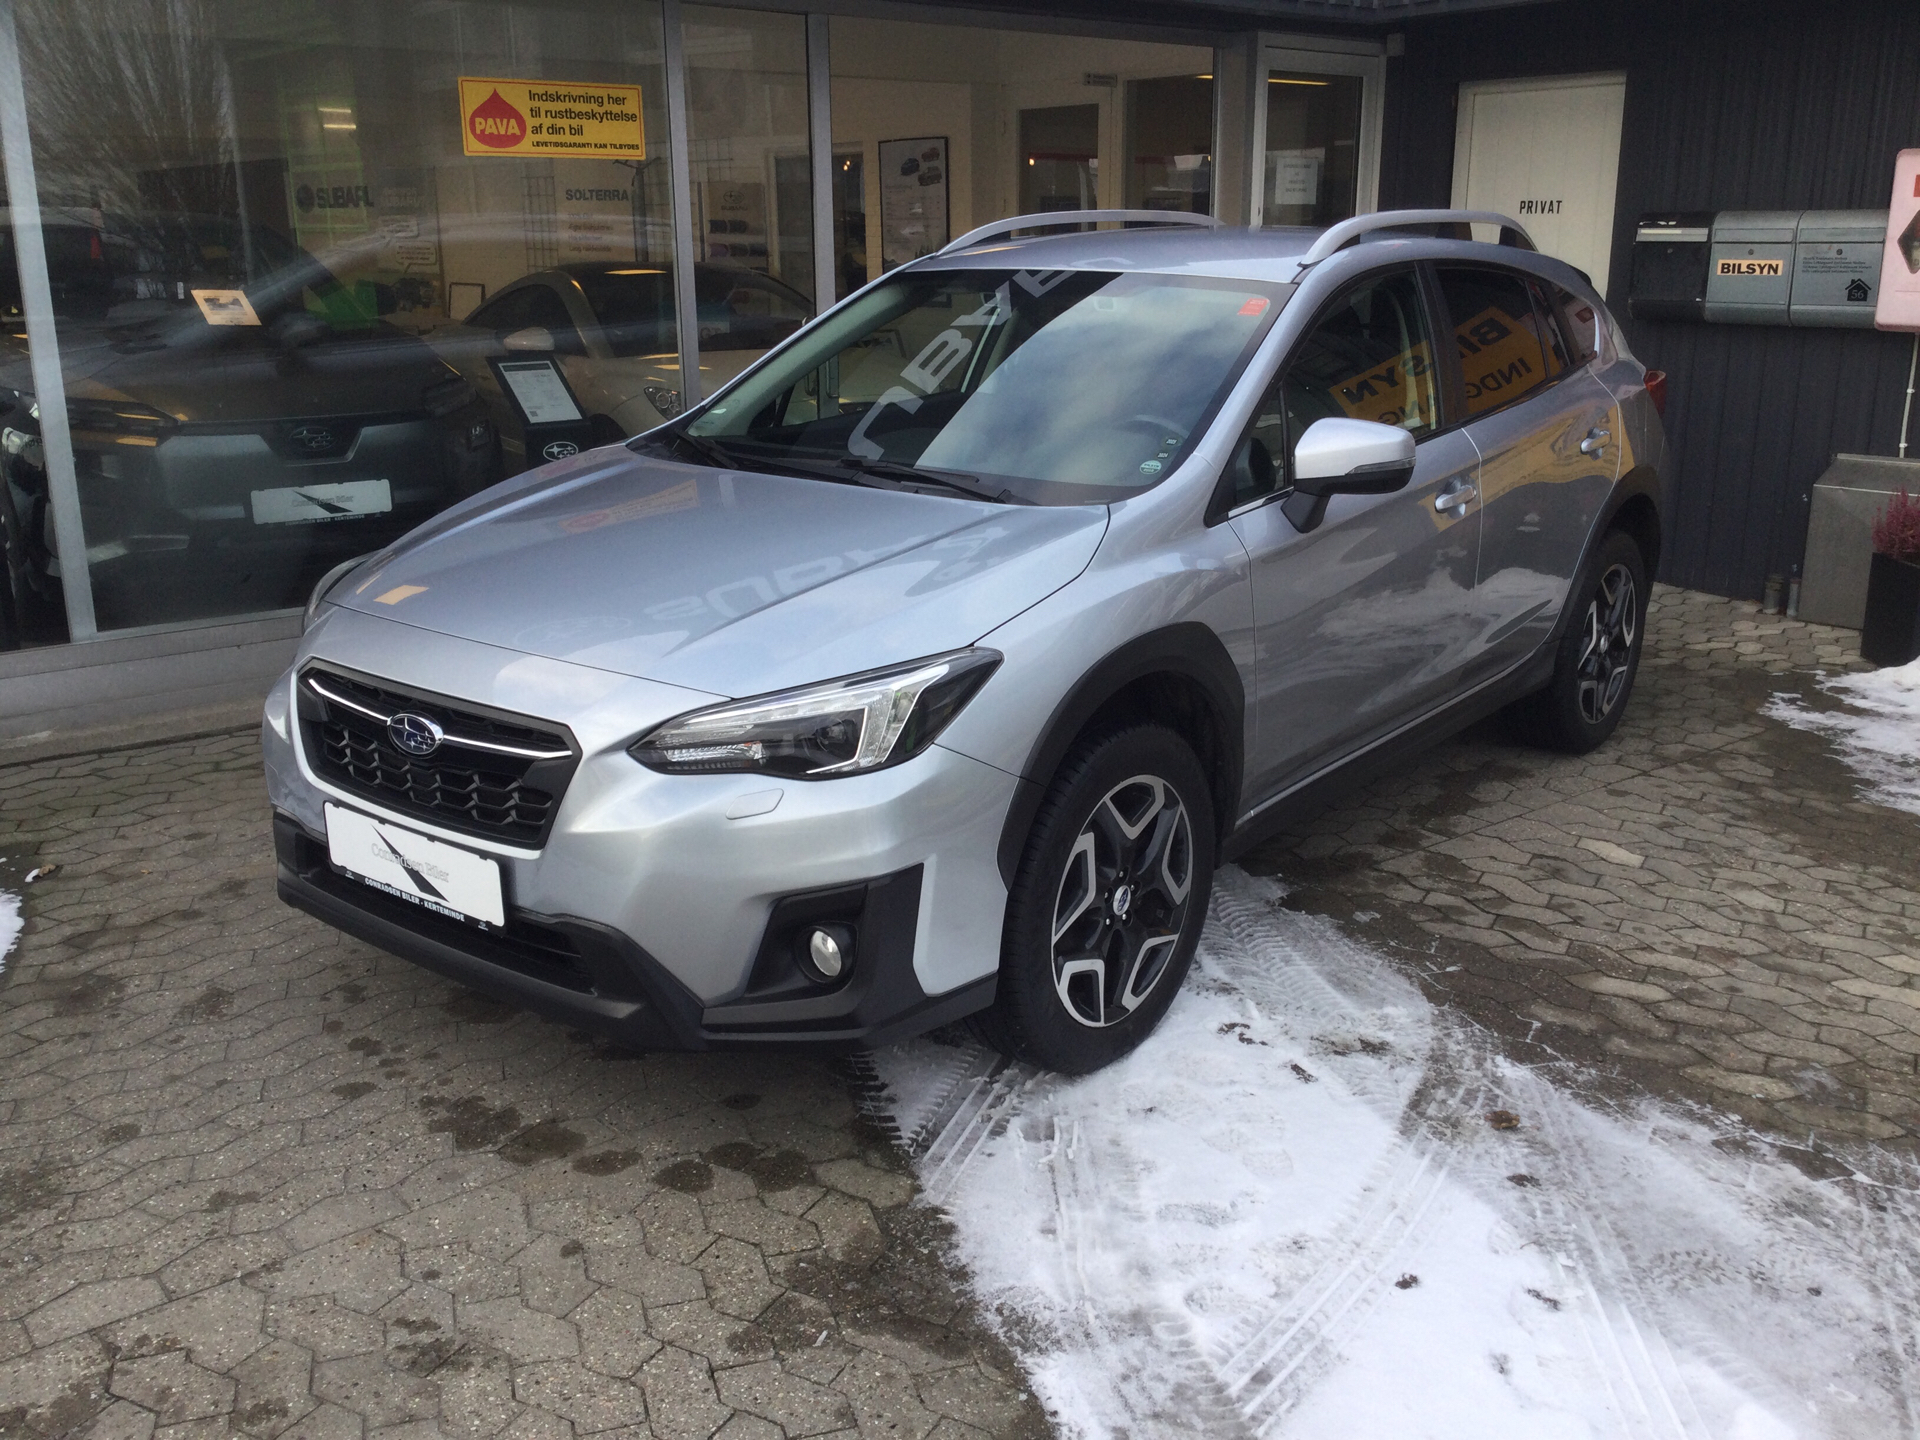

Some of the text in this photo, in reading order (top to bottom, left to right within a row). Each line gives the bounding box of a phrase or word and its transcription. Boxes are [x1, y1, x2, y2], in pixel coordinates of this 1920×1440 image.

[528, 90, 627, 107] Indskrivning her
[530, 106, 638, 123] til rustbeskyttelse
[475, 117, 521, 136] PAVA
[531, 123, 584, 136] af din bil
[532, 141, 592, 149] LEVETIDSGARANTI
[609, 143, 640, 151] TILBYDES
[565, 189, 629, 201] SOLTERRA
[1519, 200, 1562, 214] PRIVAT
[1720, 263, 1779, 275] BILSYN
[1850, 290, 1865, 300] 56
[371, 842, 450, 883] Conradsen Biler
[364, 877, 466, 922] CONRADSEN BILER KERTEMINDE
